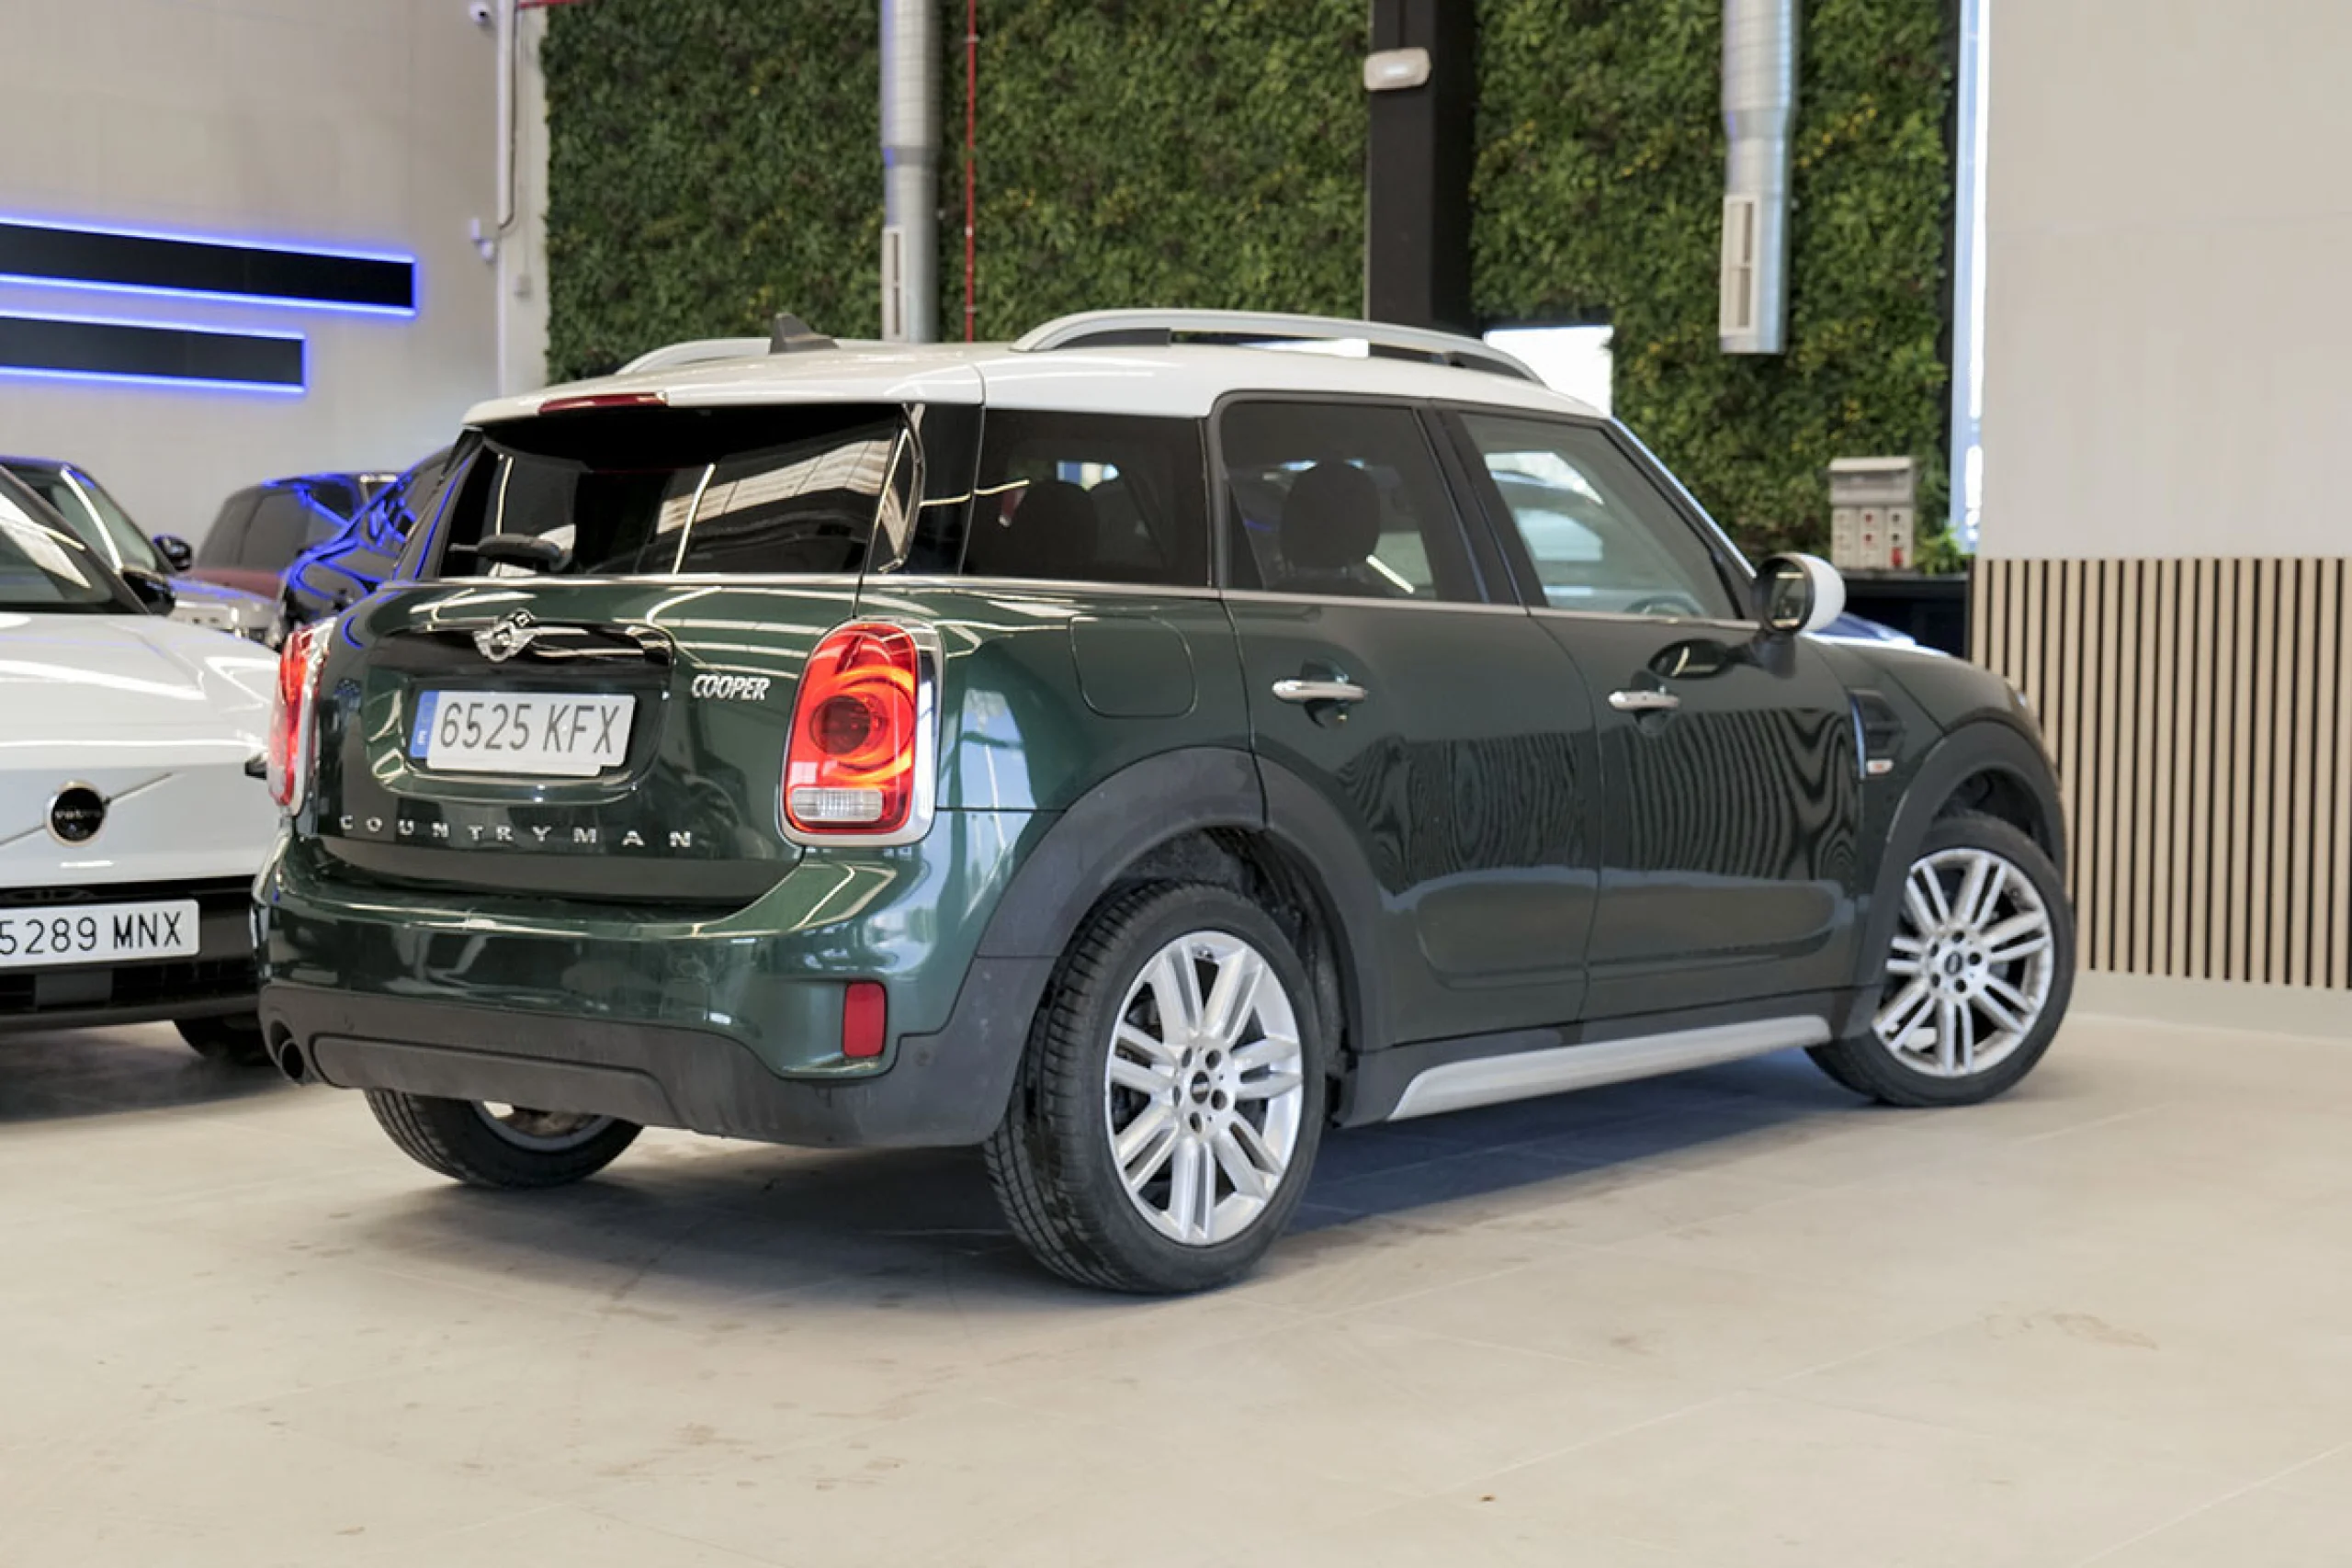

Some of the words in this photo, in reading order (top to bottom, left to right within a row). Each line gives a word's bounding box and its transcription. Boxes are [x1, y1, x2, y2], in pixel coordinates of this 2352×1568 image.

[691, 673, 771, 701] COOPER
[440, 701, 533, 752] 6525
[542, 704, 620, 754] KFX
[339, 814, 692, 848] COUNTRYMAN
[0, 916, 97, 955] 5289
[113, 910, 181, 950] MNX
